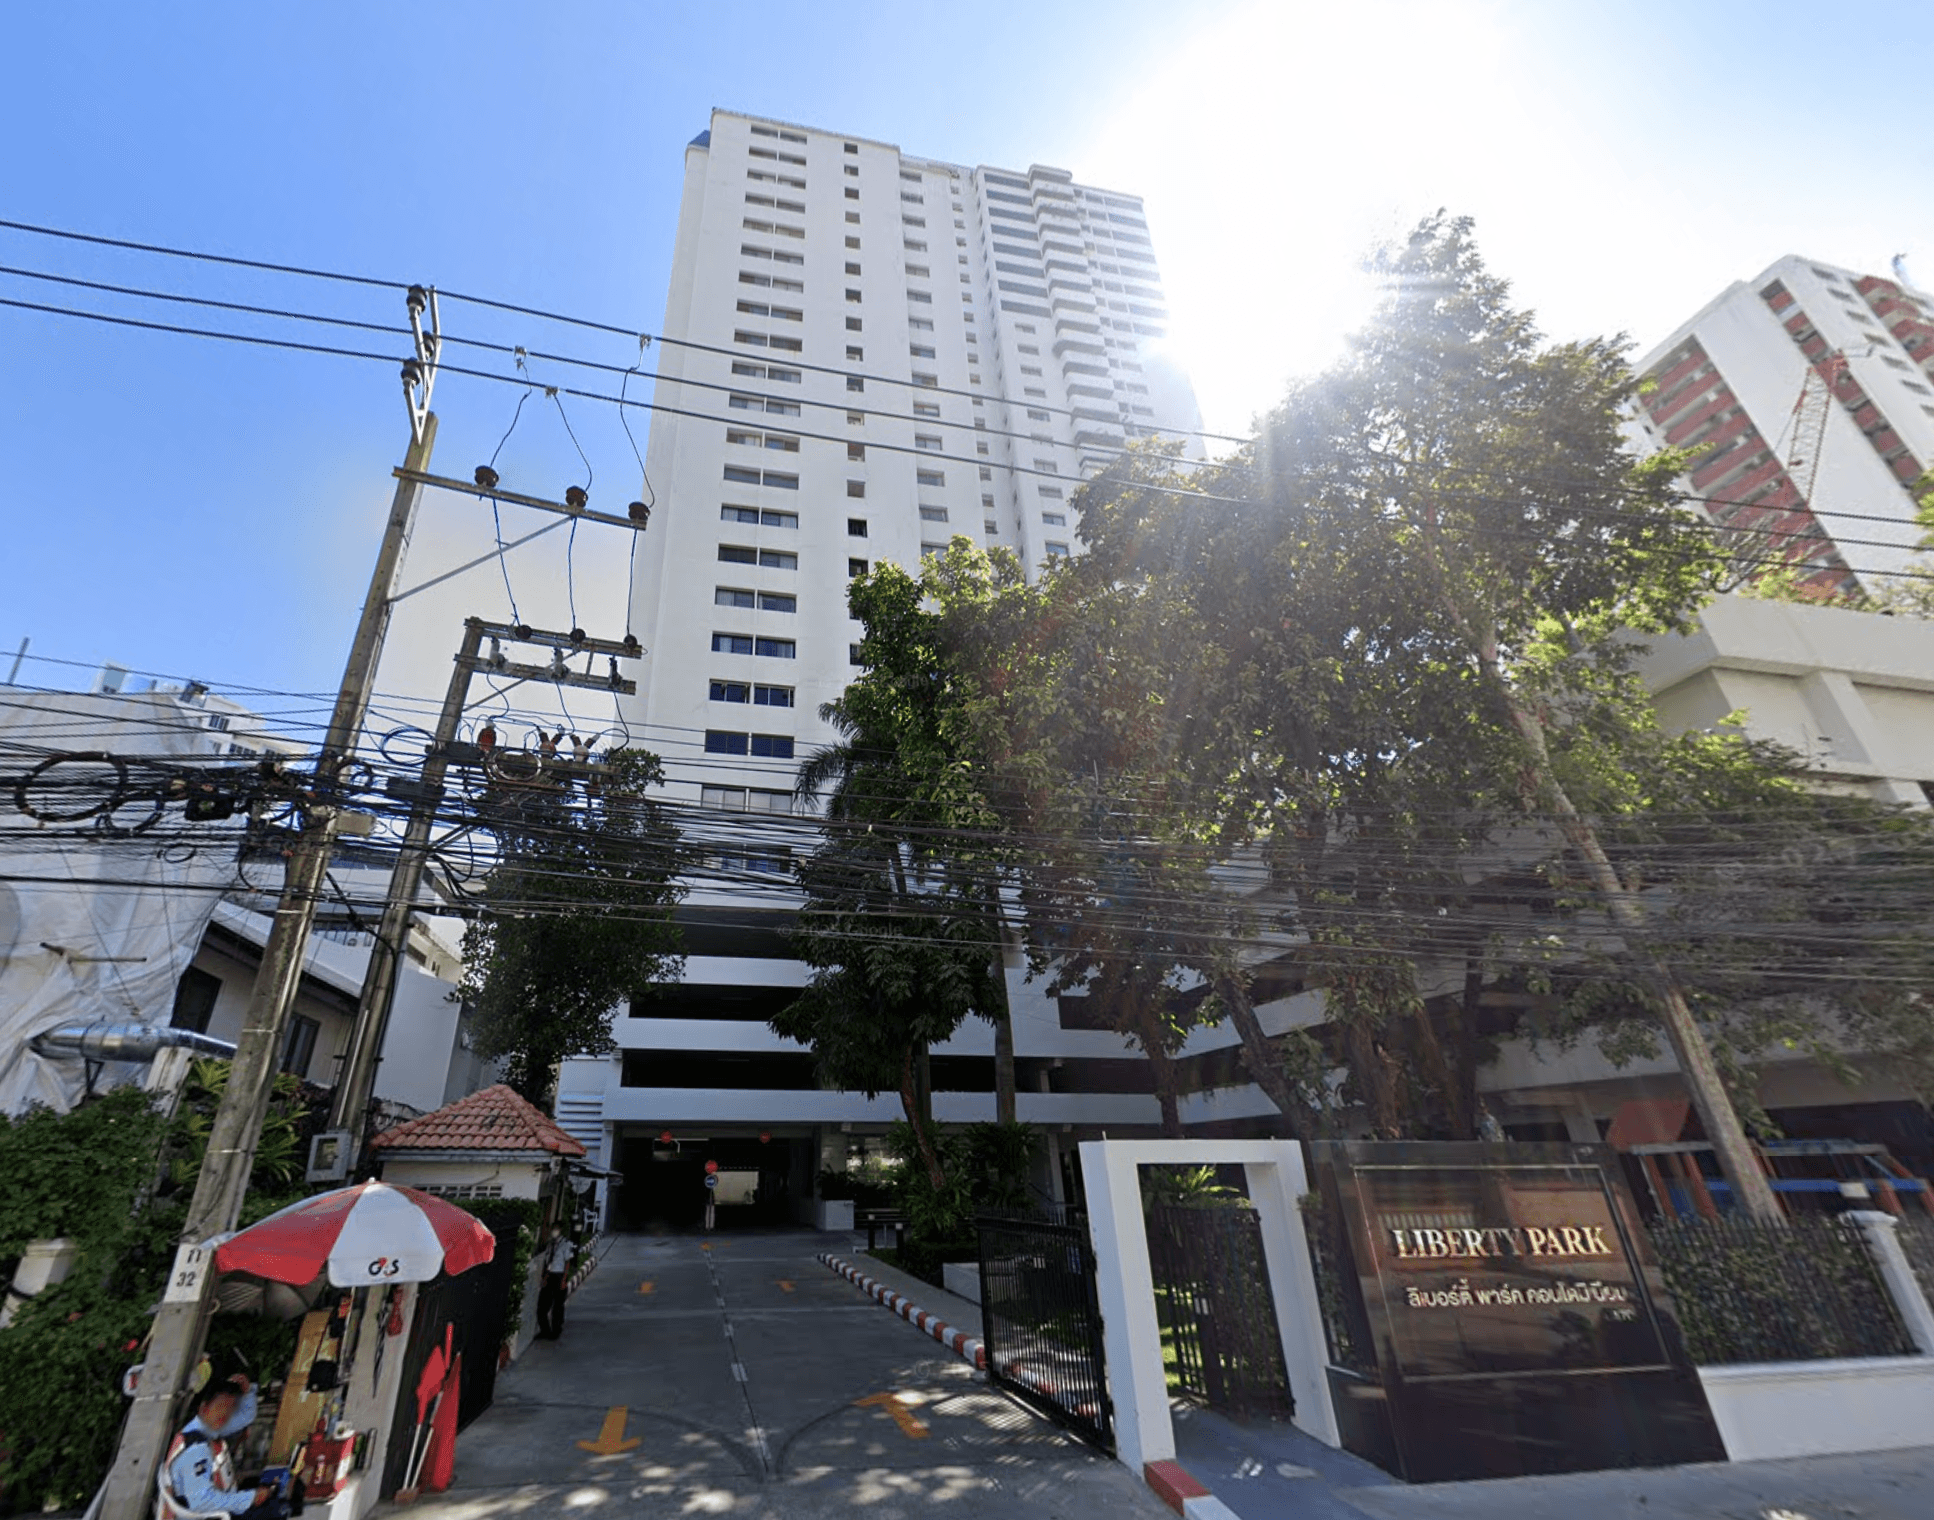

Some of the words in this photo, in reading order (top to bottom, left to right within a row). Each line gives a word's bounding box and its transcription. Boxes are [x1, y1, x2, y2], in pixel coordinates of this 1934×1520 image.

[1392, 1228, 1522, 1258] LIBERTY
[1527, 1226, 1612, 1256] PARK
[175, 1270, 198, 1287] 32
